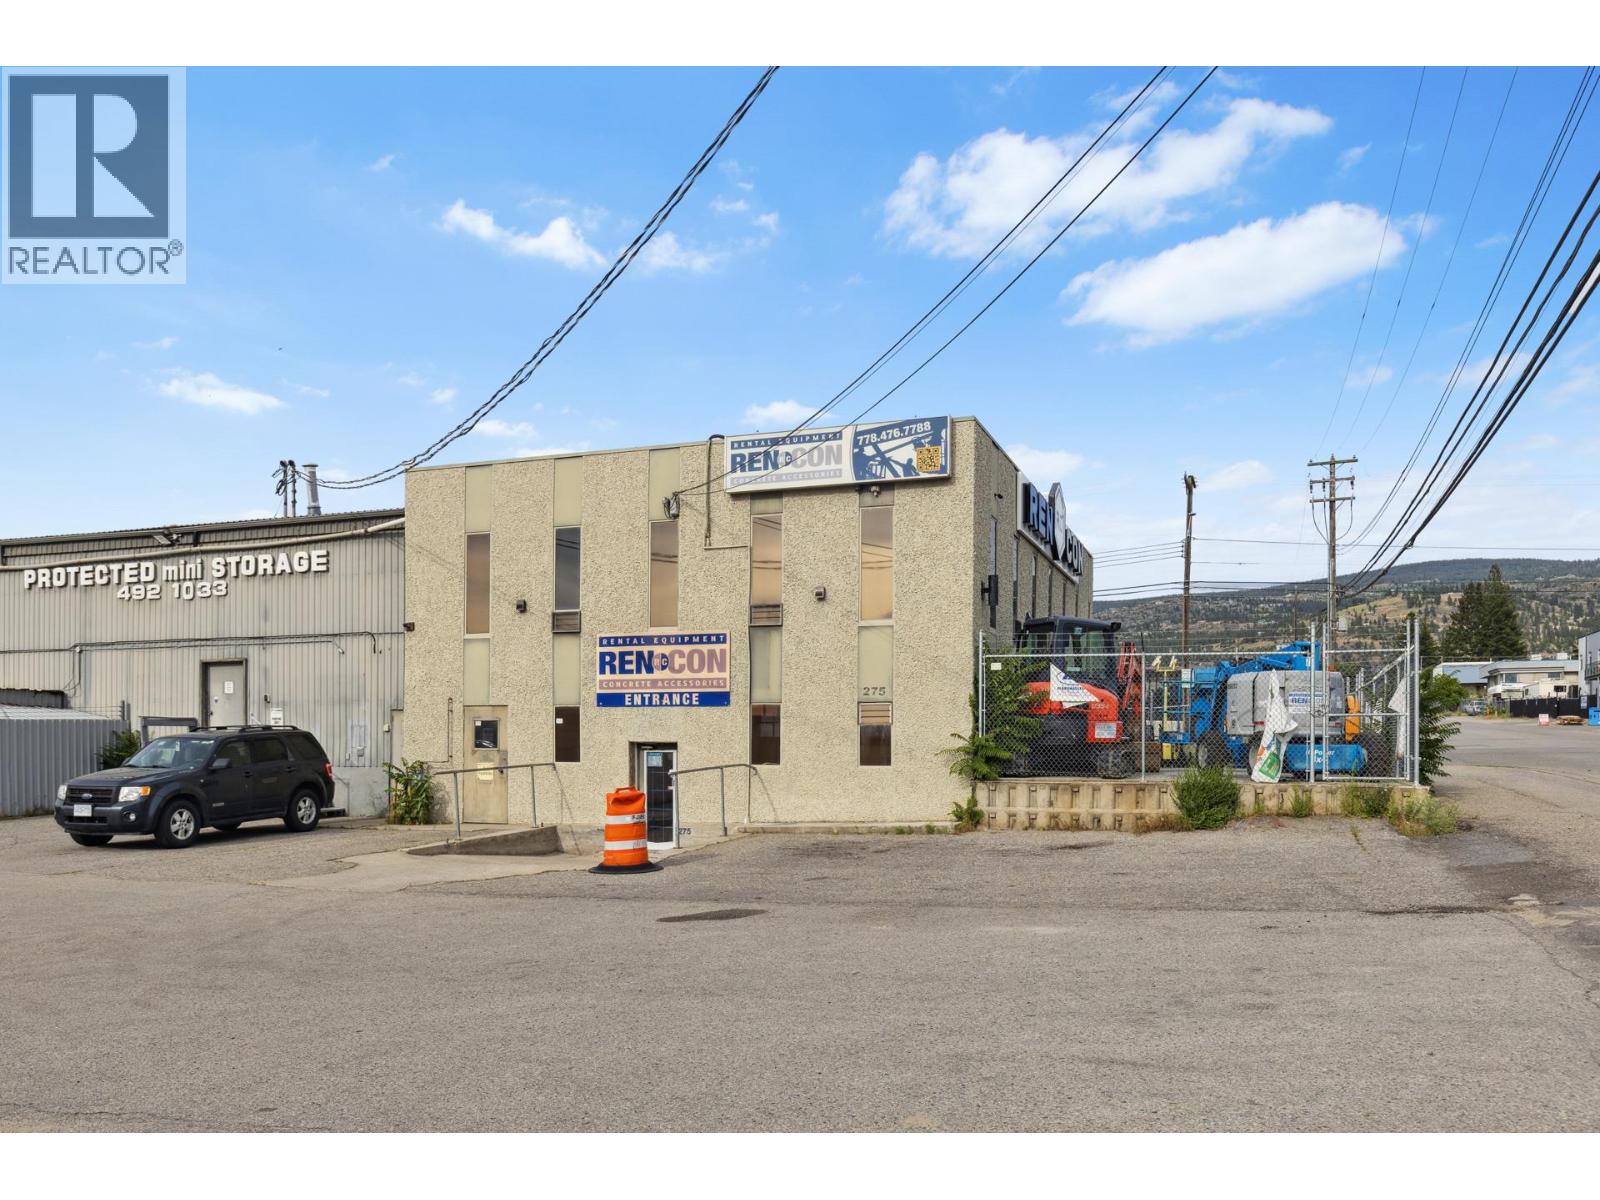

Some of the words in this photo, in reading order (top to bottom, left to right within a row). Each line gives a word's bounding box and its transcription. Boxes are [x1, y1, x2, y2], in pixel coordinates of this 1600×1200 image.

[857, 421, 931, 446] 778.476.7788
[733, 439, 772, 449] RENTAL
[23, 561, 155, 589] PROTECTED
[162, 559, 203, 582] mini
[211, 550, 329, 578] STORAGE
[116, 584, 161, 601] 492
[172, 581, 228, 600] 1033
[602, 637, 646, 645] RENTAL
[653, 635, 725, 644] EQUIPMENT
[657, 679, 725, 687] ACCESSORIES
[863, 686, 886, 696] 275
[624, 693, 700, 706] ENTRANCE
